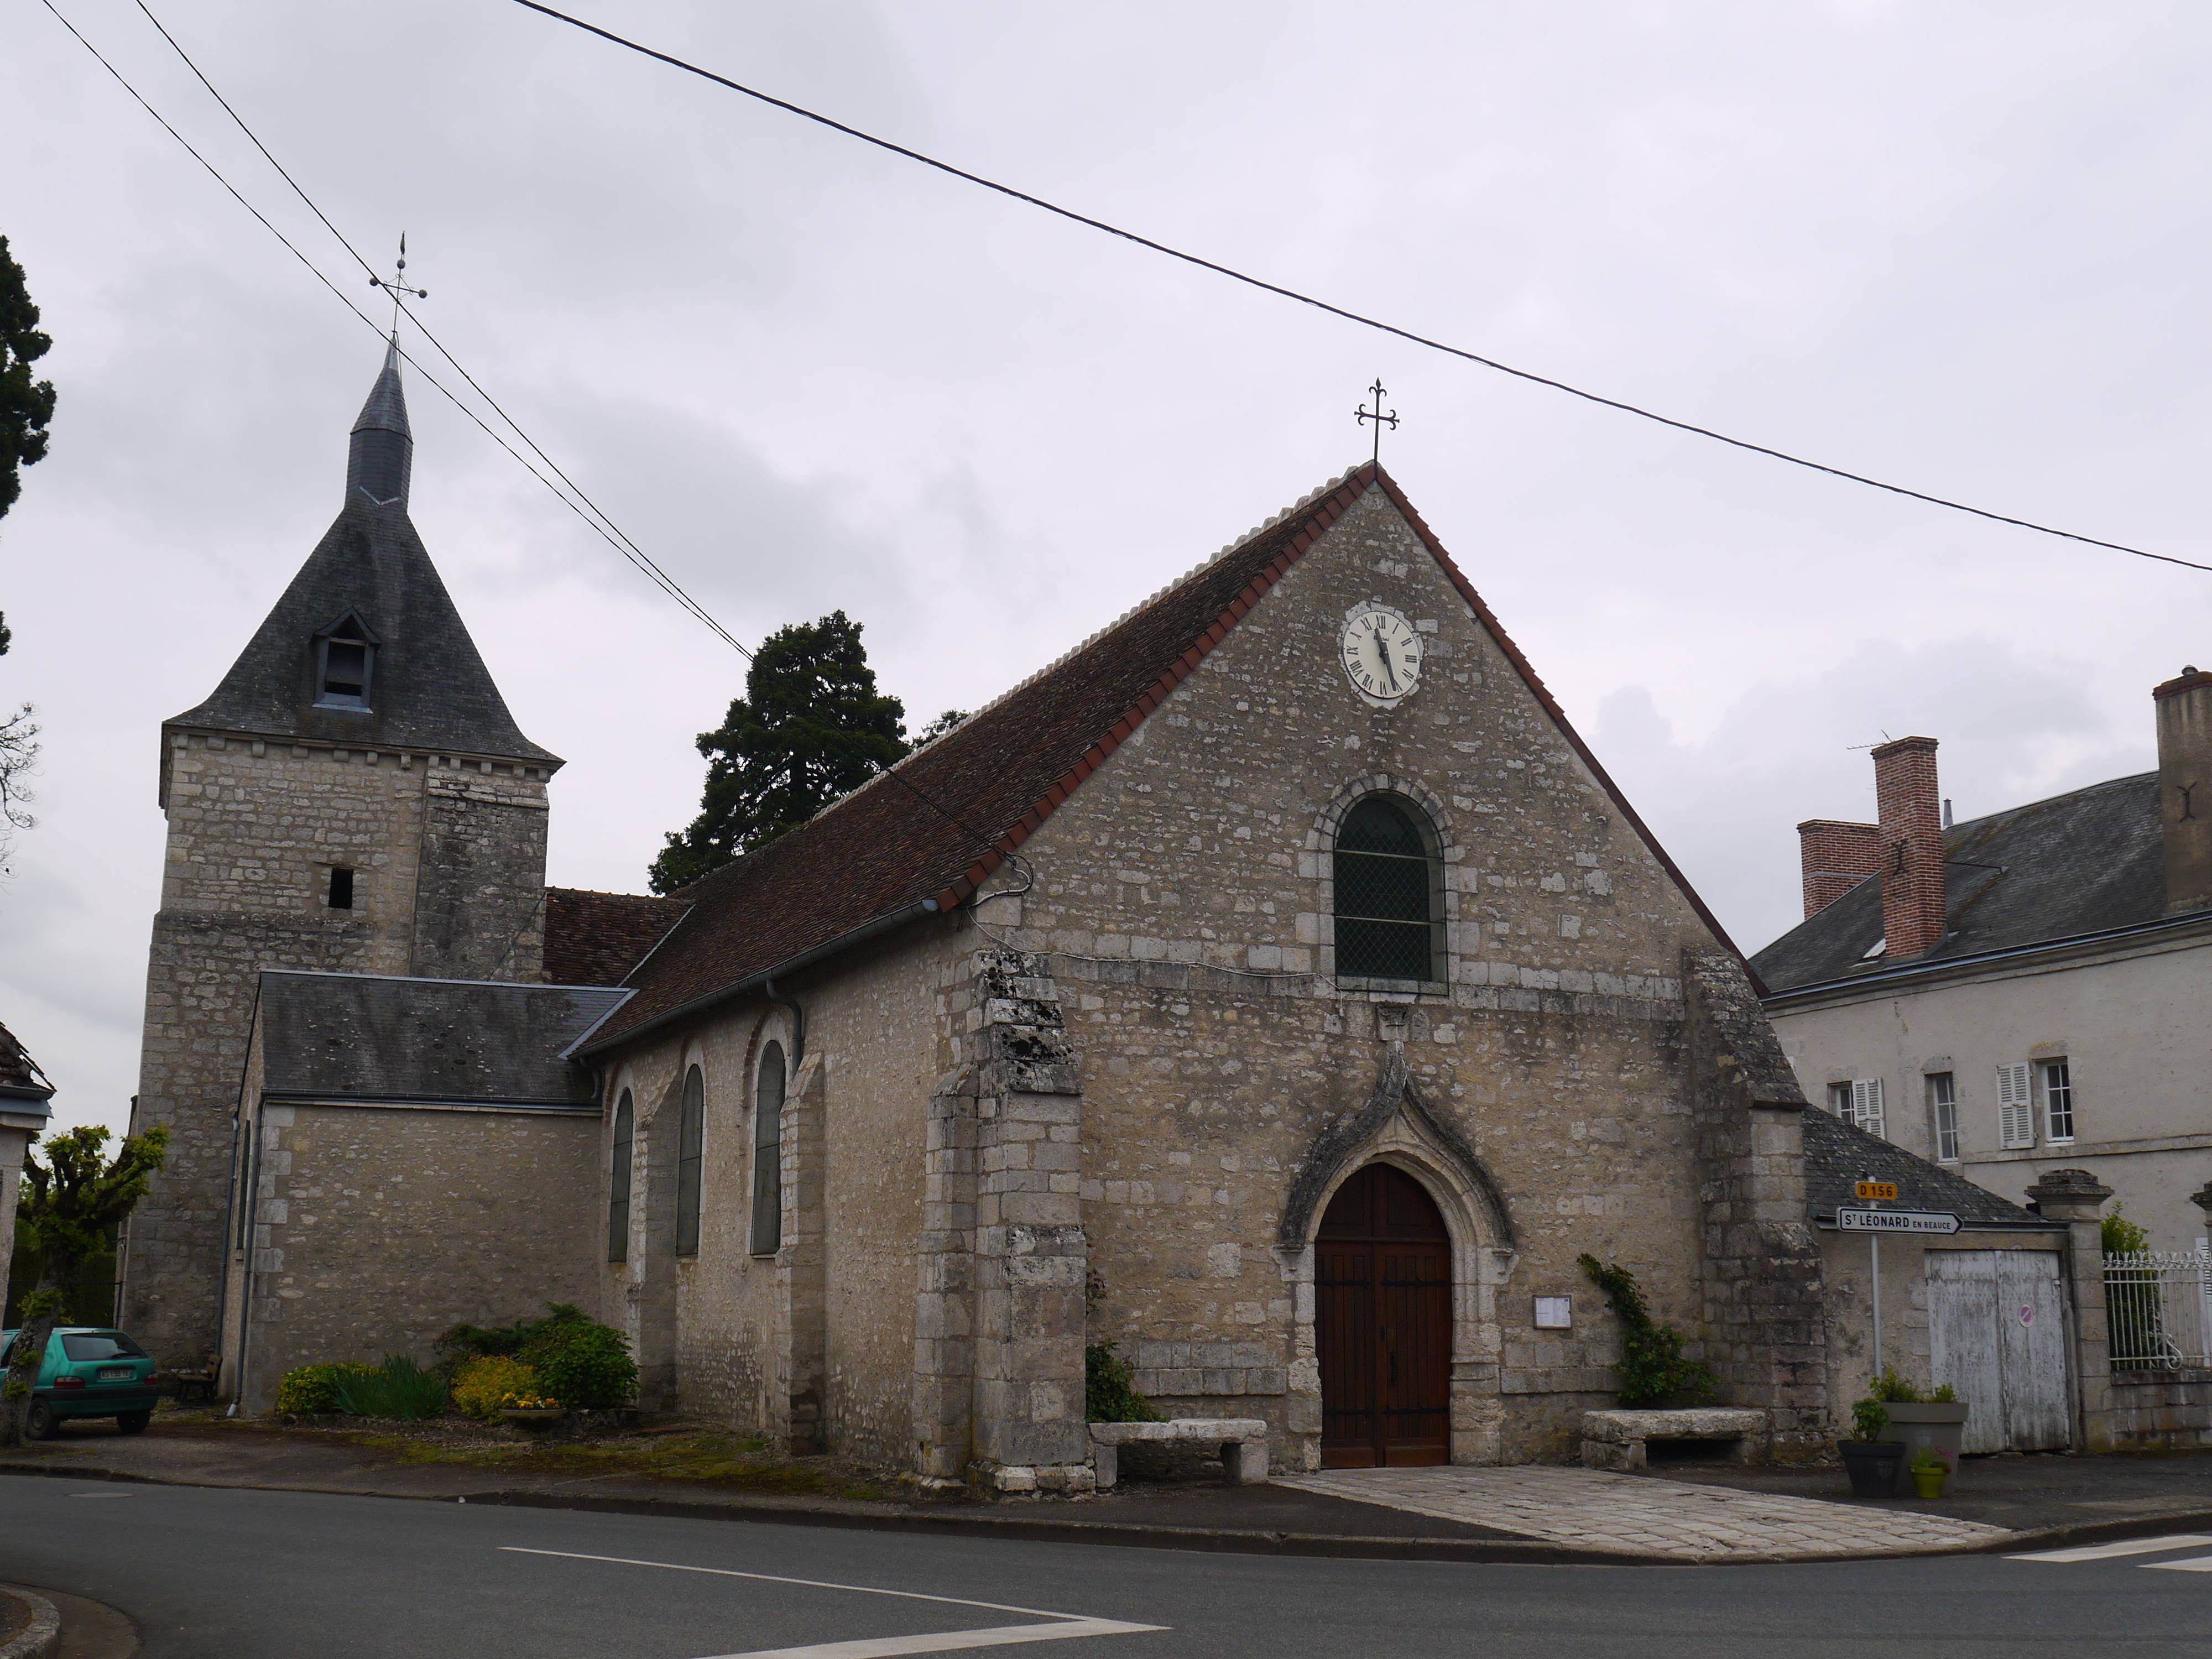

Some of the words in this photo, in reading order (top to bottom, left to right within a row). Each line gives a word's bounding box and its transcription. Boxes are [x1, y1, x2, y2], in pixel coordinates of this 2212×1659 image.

[1861, 1185, 1867, 1195] D
[1871, 1186, 1893, 1197] 156
[1860, 1213, 1910, 1228] LÉONARD
